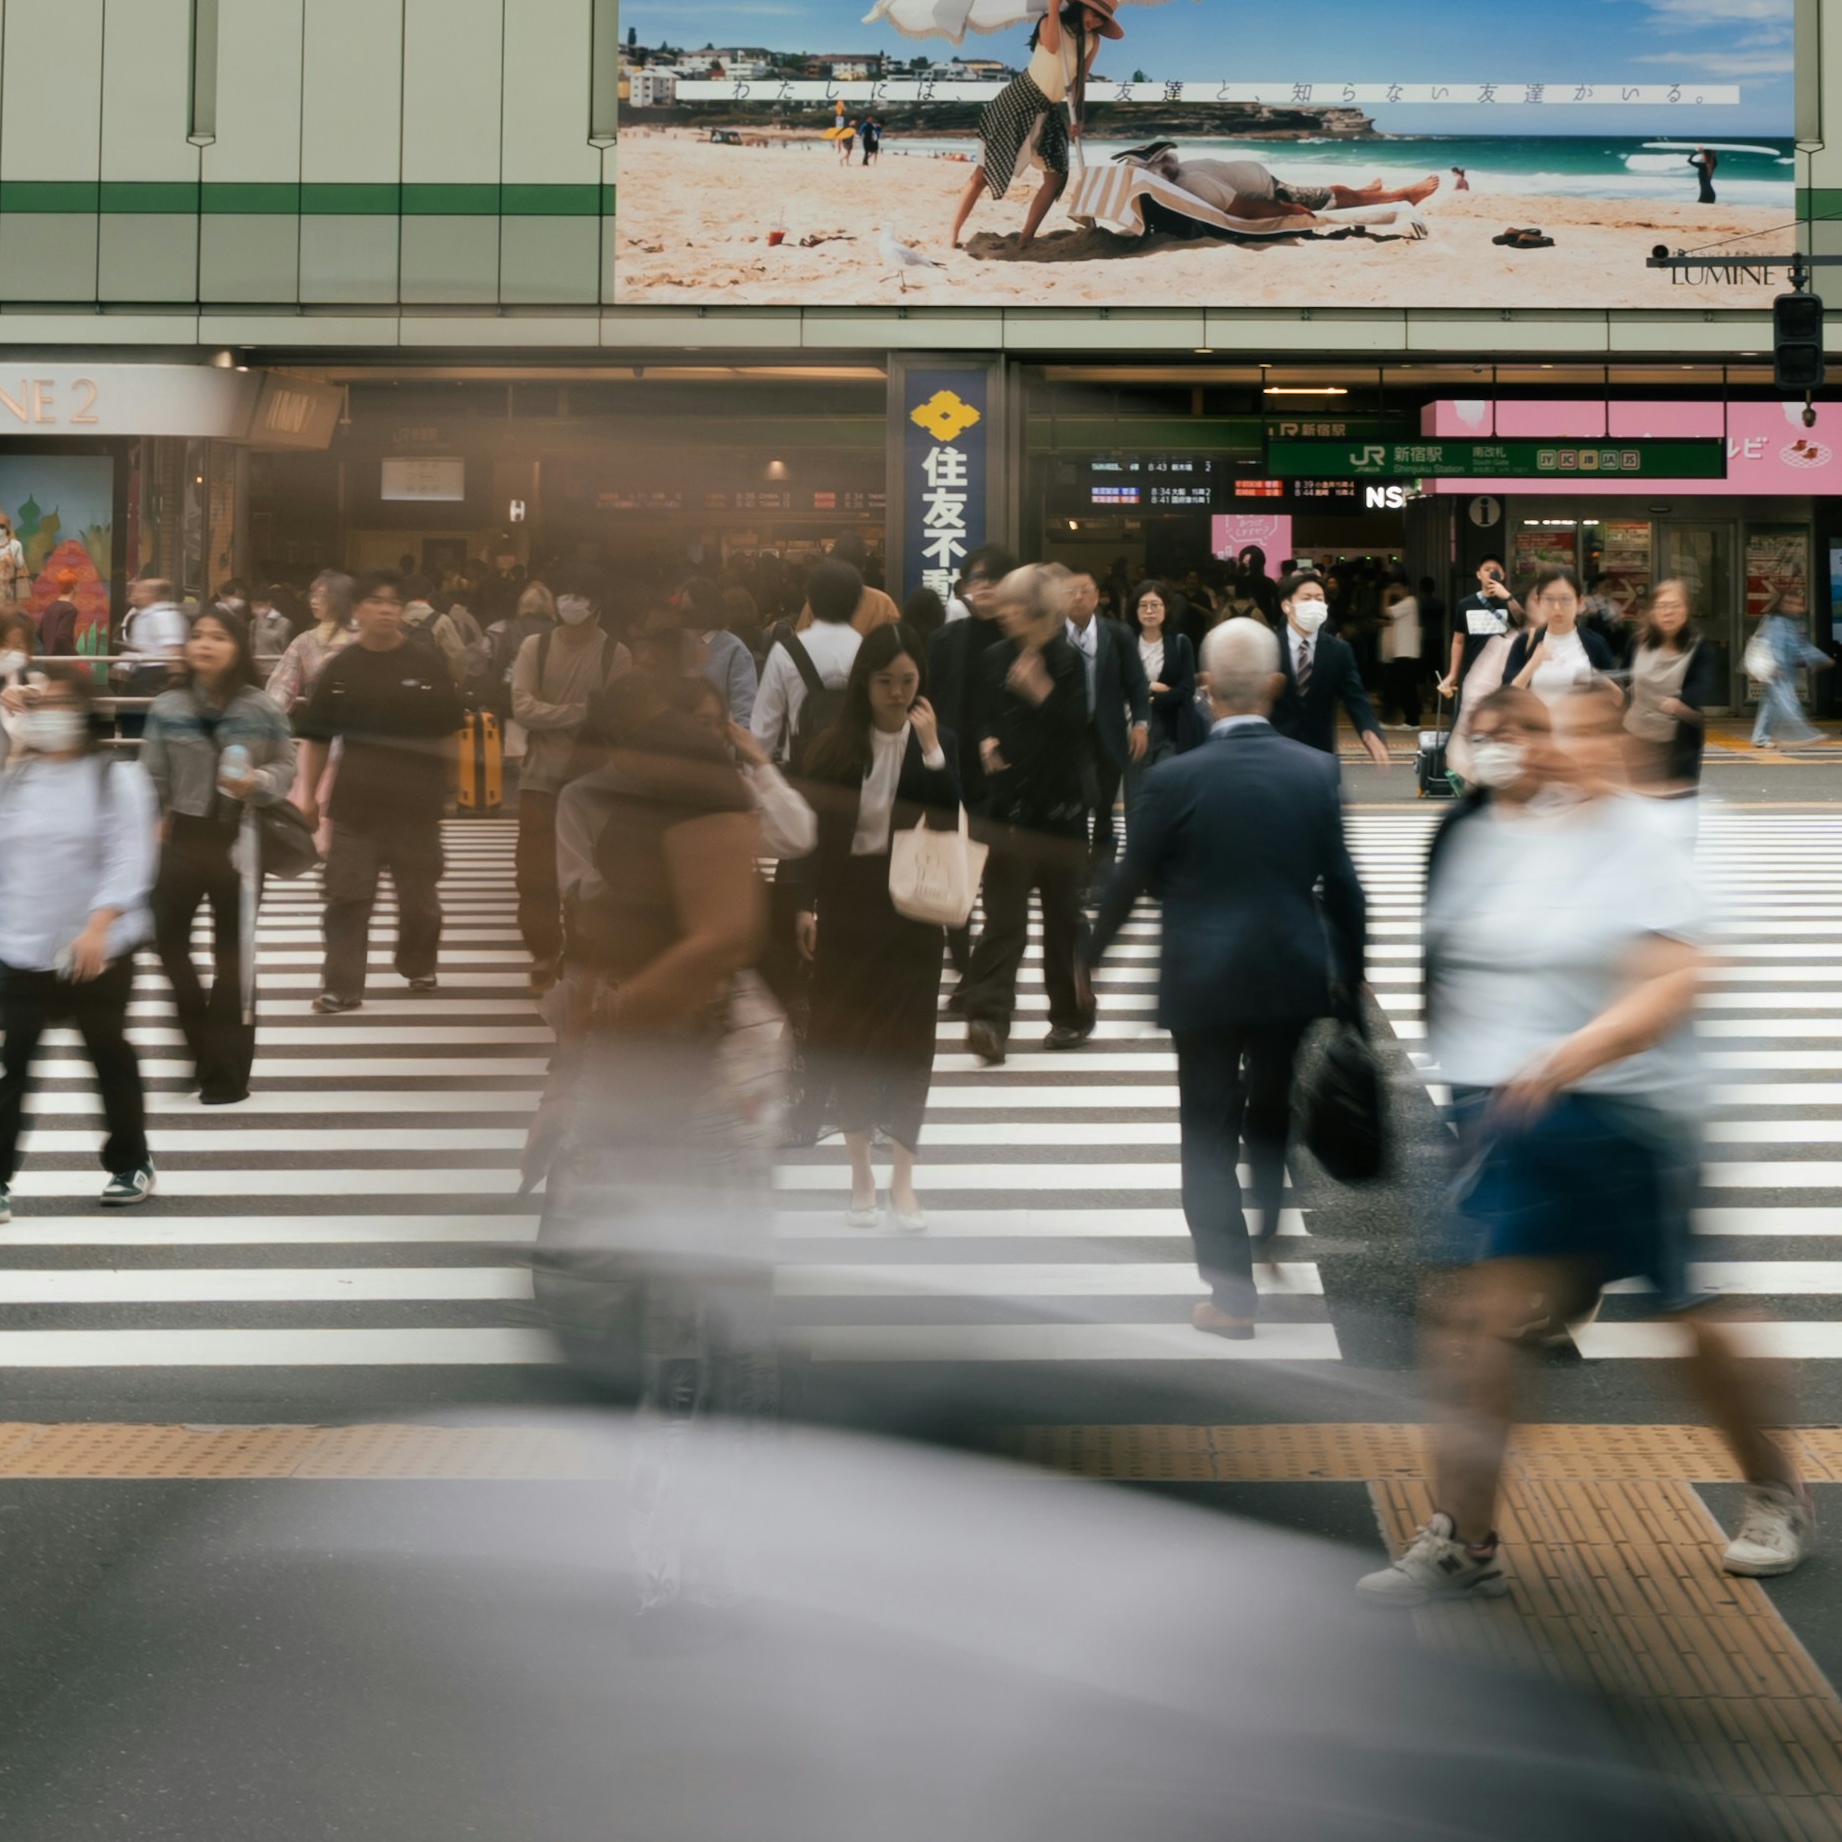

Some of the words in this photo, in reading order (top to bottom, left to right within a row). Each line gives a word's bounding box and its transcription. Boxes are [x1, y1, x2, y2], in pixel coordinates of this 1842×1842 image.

[69, 378, 99, 424] 2
[1301, 423, 1346, 437] 新宿駅
[1349, 446, 1386, 466] JR
[1393, 446, 1444, 463] 新宿駅
[1472, 446, 1507, 458] 南改札
[1393, 464, 1433, 475] Shinjuku
[1436, 464, 1466, 474] Station
